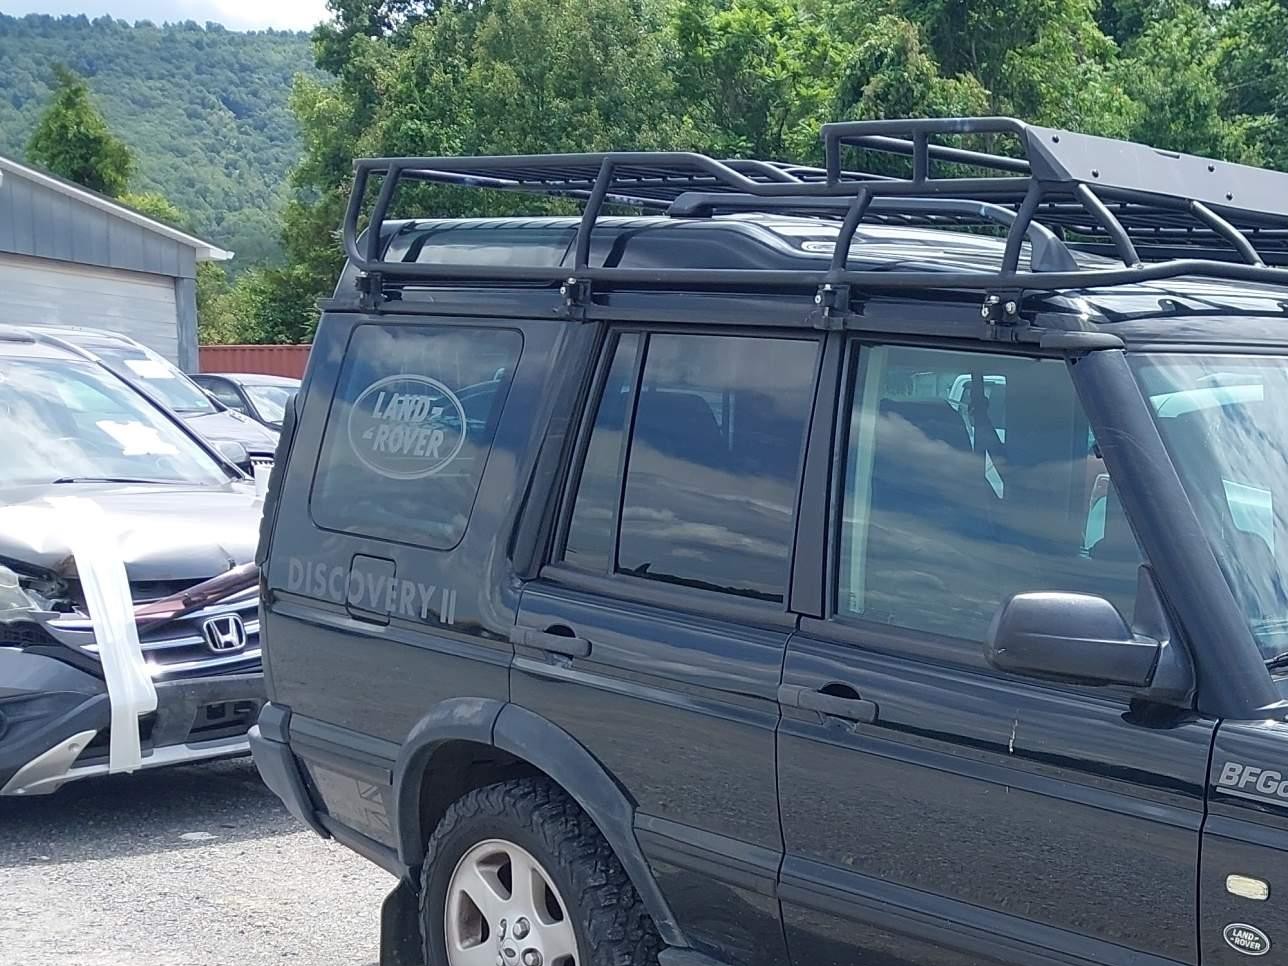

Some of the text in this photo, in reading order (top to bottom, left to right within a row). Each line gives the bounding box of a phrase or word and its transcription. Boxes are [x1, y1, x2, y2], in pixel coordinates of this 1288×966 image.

[371, 391, 431, 423] LAND
[372, 424, 444, 459] ROVER
[287, 557, 457, 625] DISCOVERY II
[1232, 928, 1255, 941] LAND
[1234, 938, 1261, 951] ROVER
